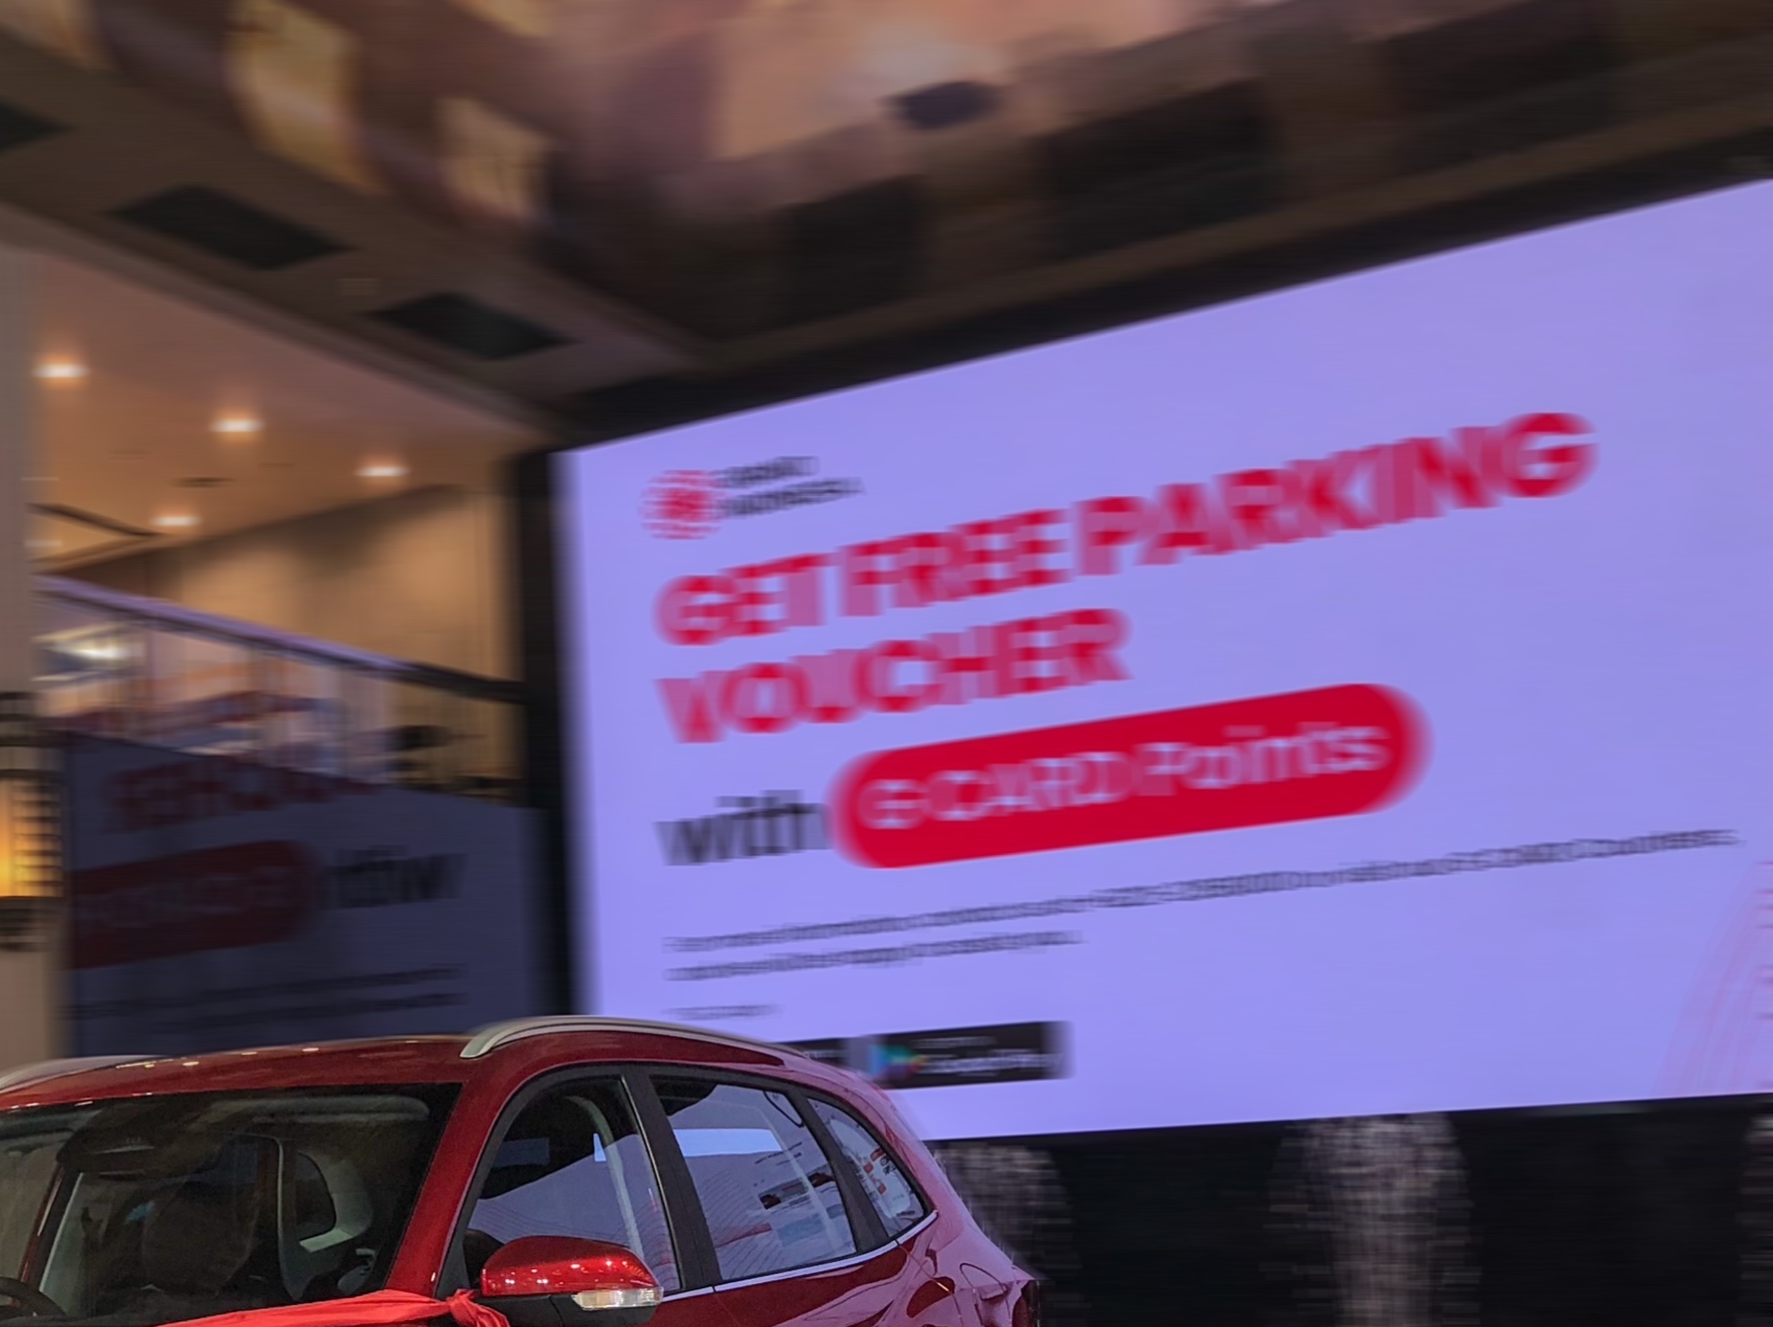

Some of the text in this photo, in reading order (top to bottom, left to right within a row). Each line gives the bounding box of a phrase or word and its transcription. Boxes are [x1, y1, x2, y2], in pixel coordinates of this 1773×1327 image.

[652, 412, 1599, 646] GET FREE PARKING
[654, 608, 1132, 744] VOUCHER
[654, 789, 833, 866] with
[924, 751, 1134, 821] CARD
[1135, 722, 1393, 796] Points
